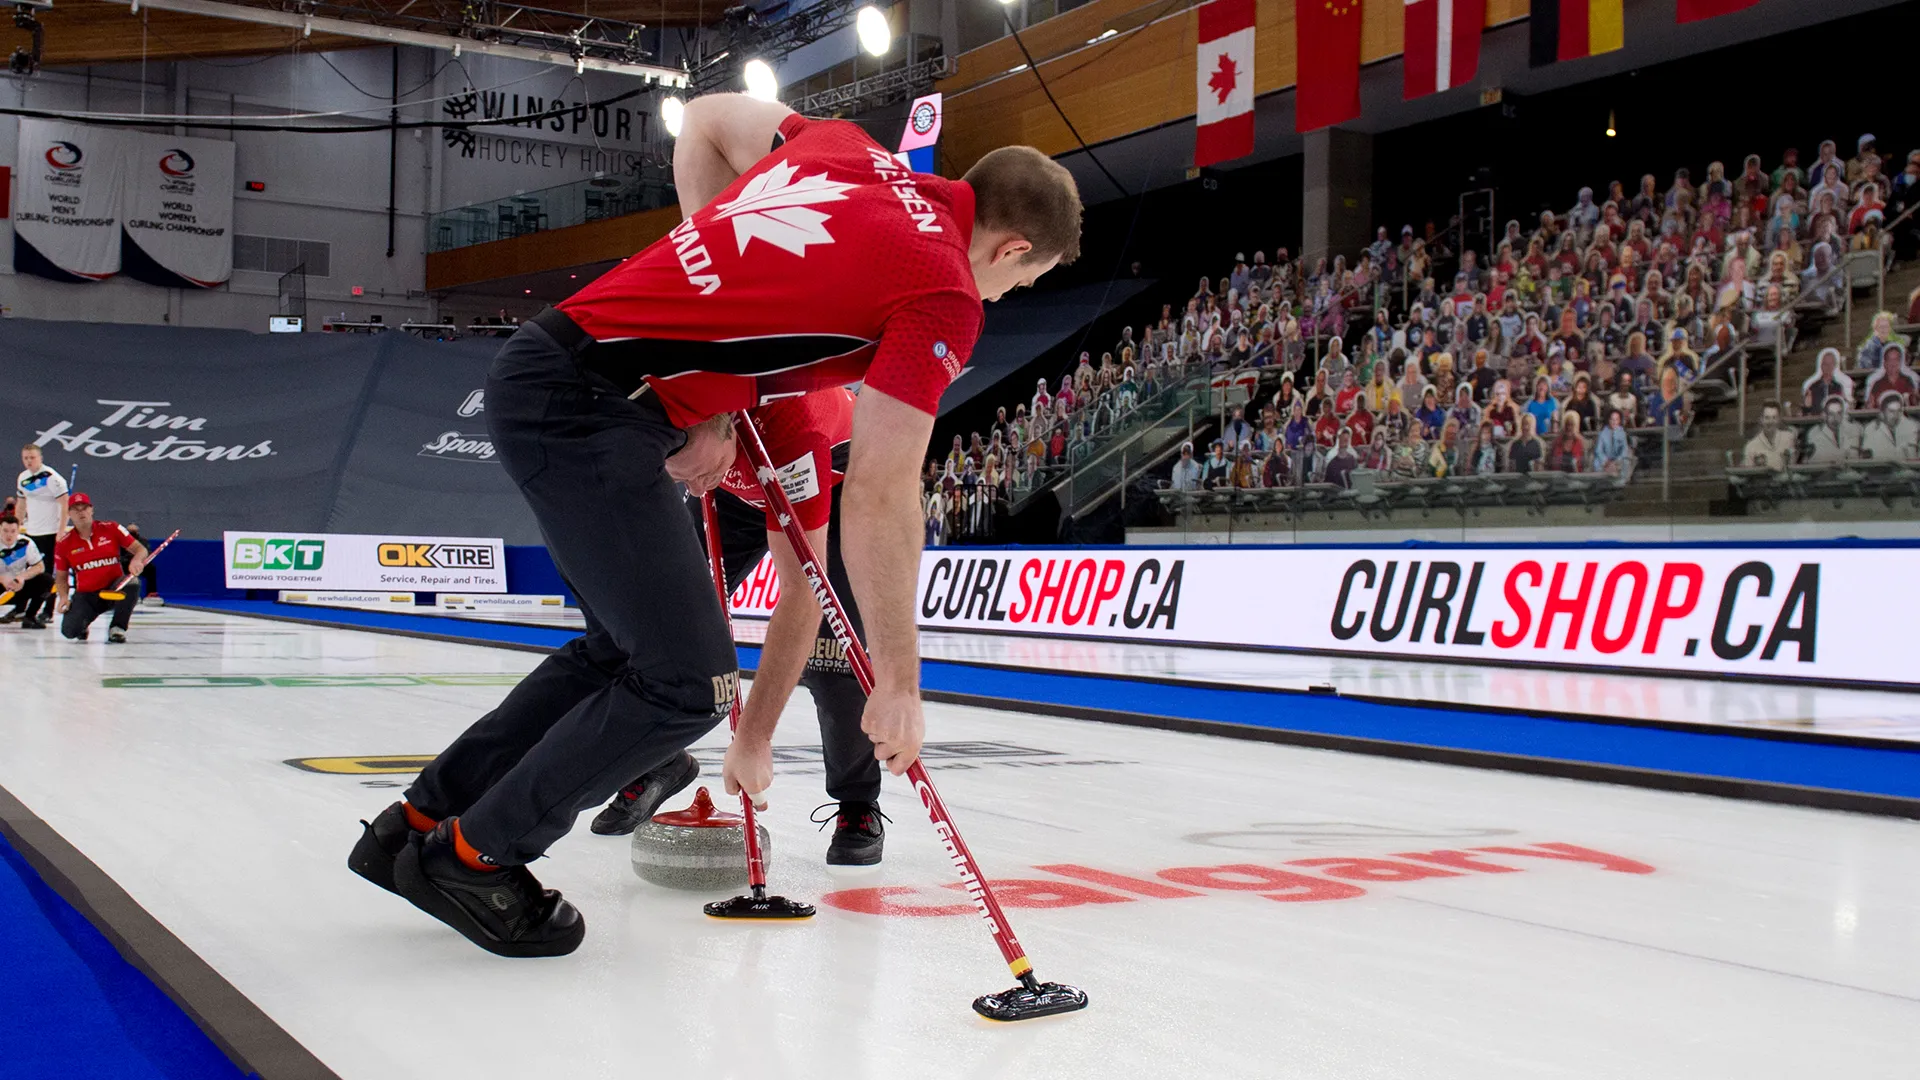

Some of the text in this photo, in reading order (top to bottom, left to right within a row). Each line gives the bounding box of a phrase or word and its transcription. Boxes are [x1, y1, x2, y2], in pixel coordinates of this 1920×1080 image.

[483, 91, 651, 143] WINSPORT
[480, 137, 567, 169] HOCKEY
[48, 193, 81, 204] WORLD
[51, 205, 77, 215] MEN'S
[162, 201, 193, 212] WORLD
[52, 216, 115, 227] CHAMPIONSHIP
[158, 212, 197, 223] WOMEN'S
[129, 220, 226, 237] CURLING CHAMPIONSHIP
[97, 399, 208, 431] Tim
[34, 420, 273, 461] Hortons
[234, 541, 325, 569] BKT
[377, 543, 492, 568] OK TIRE
[231, 574, 323, 583] GROWING TOGETHER
[380, 574, 499, 586] Service, Repair and Tires.
[317, 594, 381, 602] newholland.com
[922, 557, 1186, 630] CURLSHOP.CA
[473, 597, 533, 606] newholland.com
[802, 560, 853, 654] CANADA
[1330, 558, 1822, 663] CURLSHOP.CA
[807, 658, 850, 669] VODKA
[751, 903, 771, 911] AIR
[1035, 996, 1052, 1007] AIR
